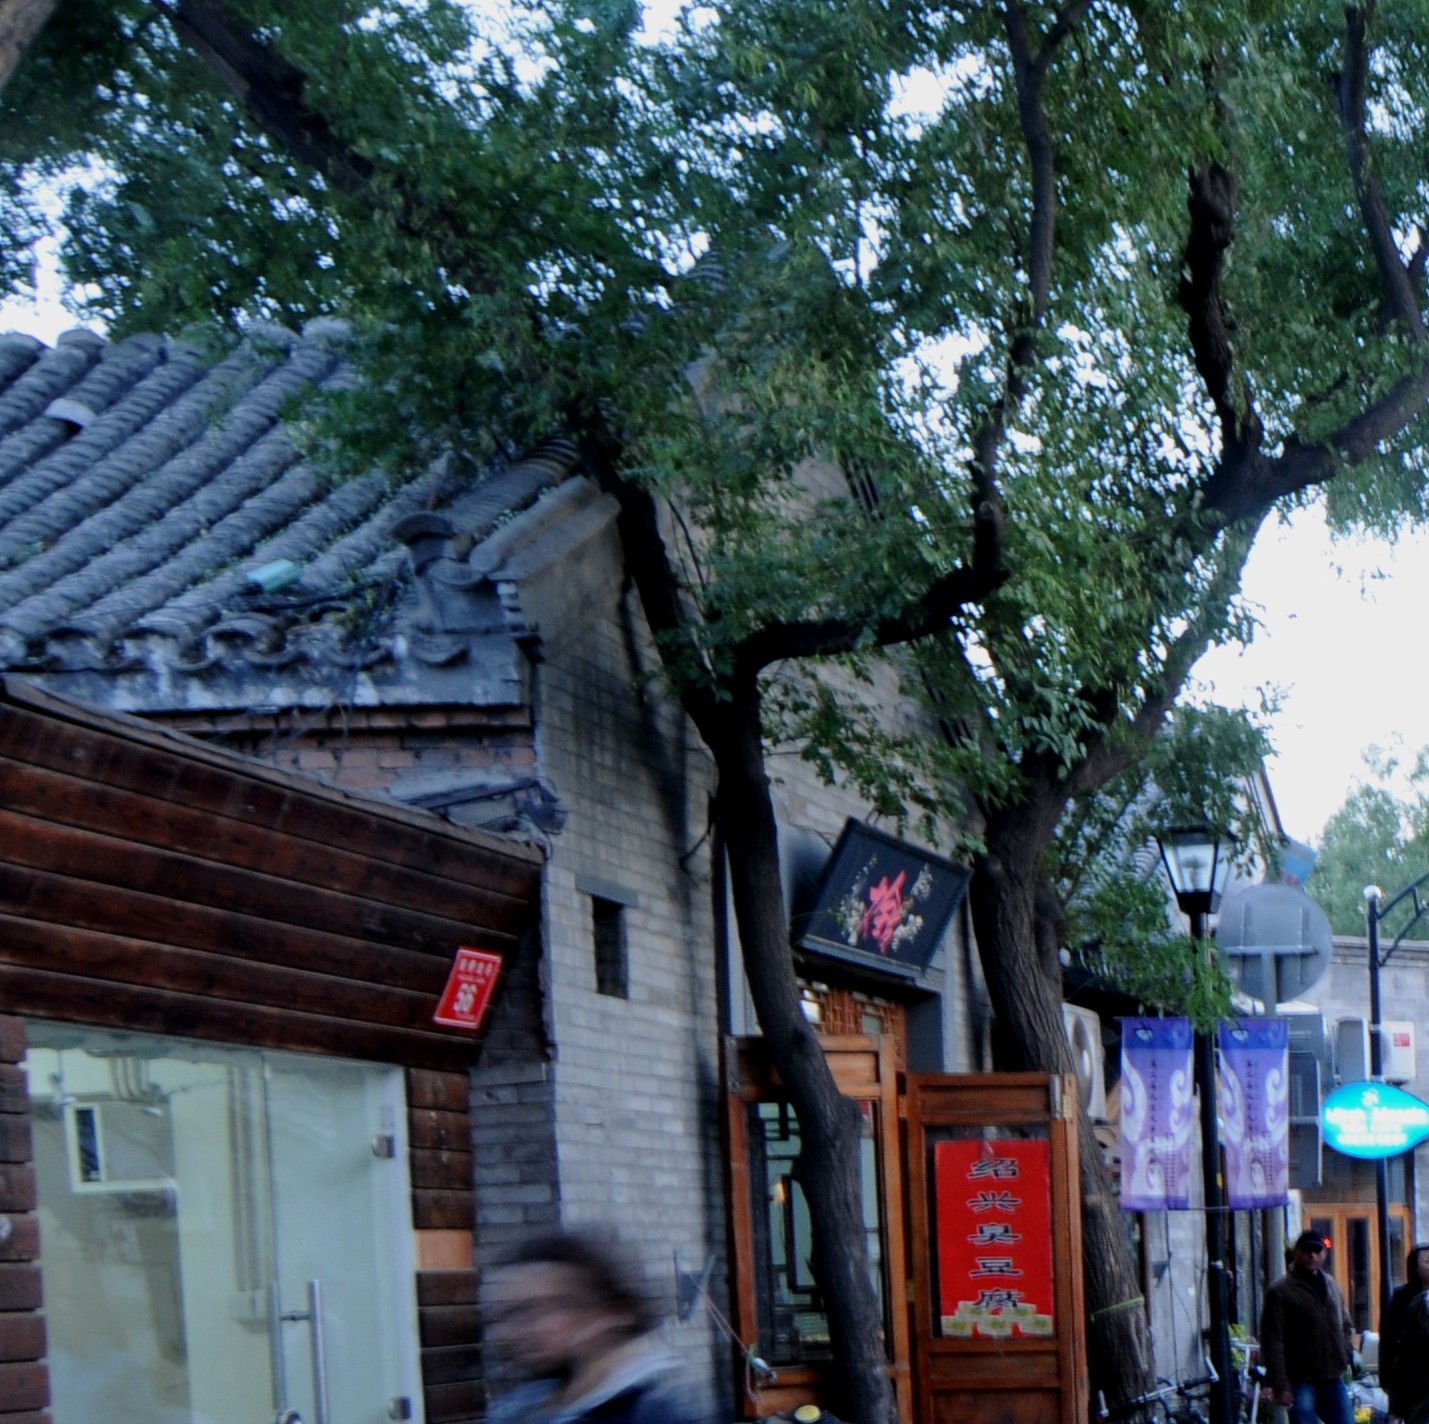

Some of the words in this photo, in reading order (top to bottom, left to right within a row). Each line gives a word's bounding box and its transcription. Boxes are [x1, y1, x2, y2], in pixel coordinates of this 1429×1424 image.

[967, 1157, 1024, 1309] 绍兴臭豆腐
